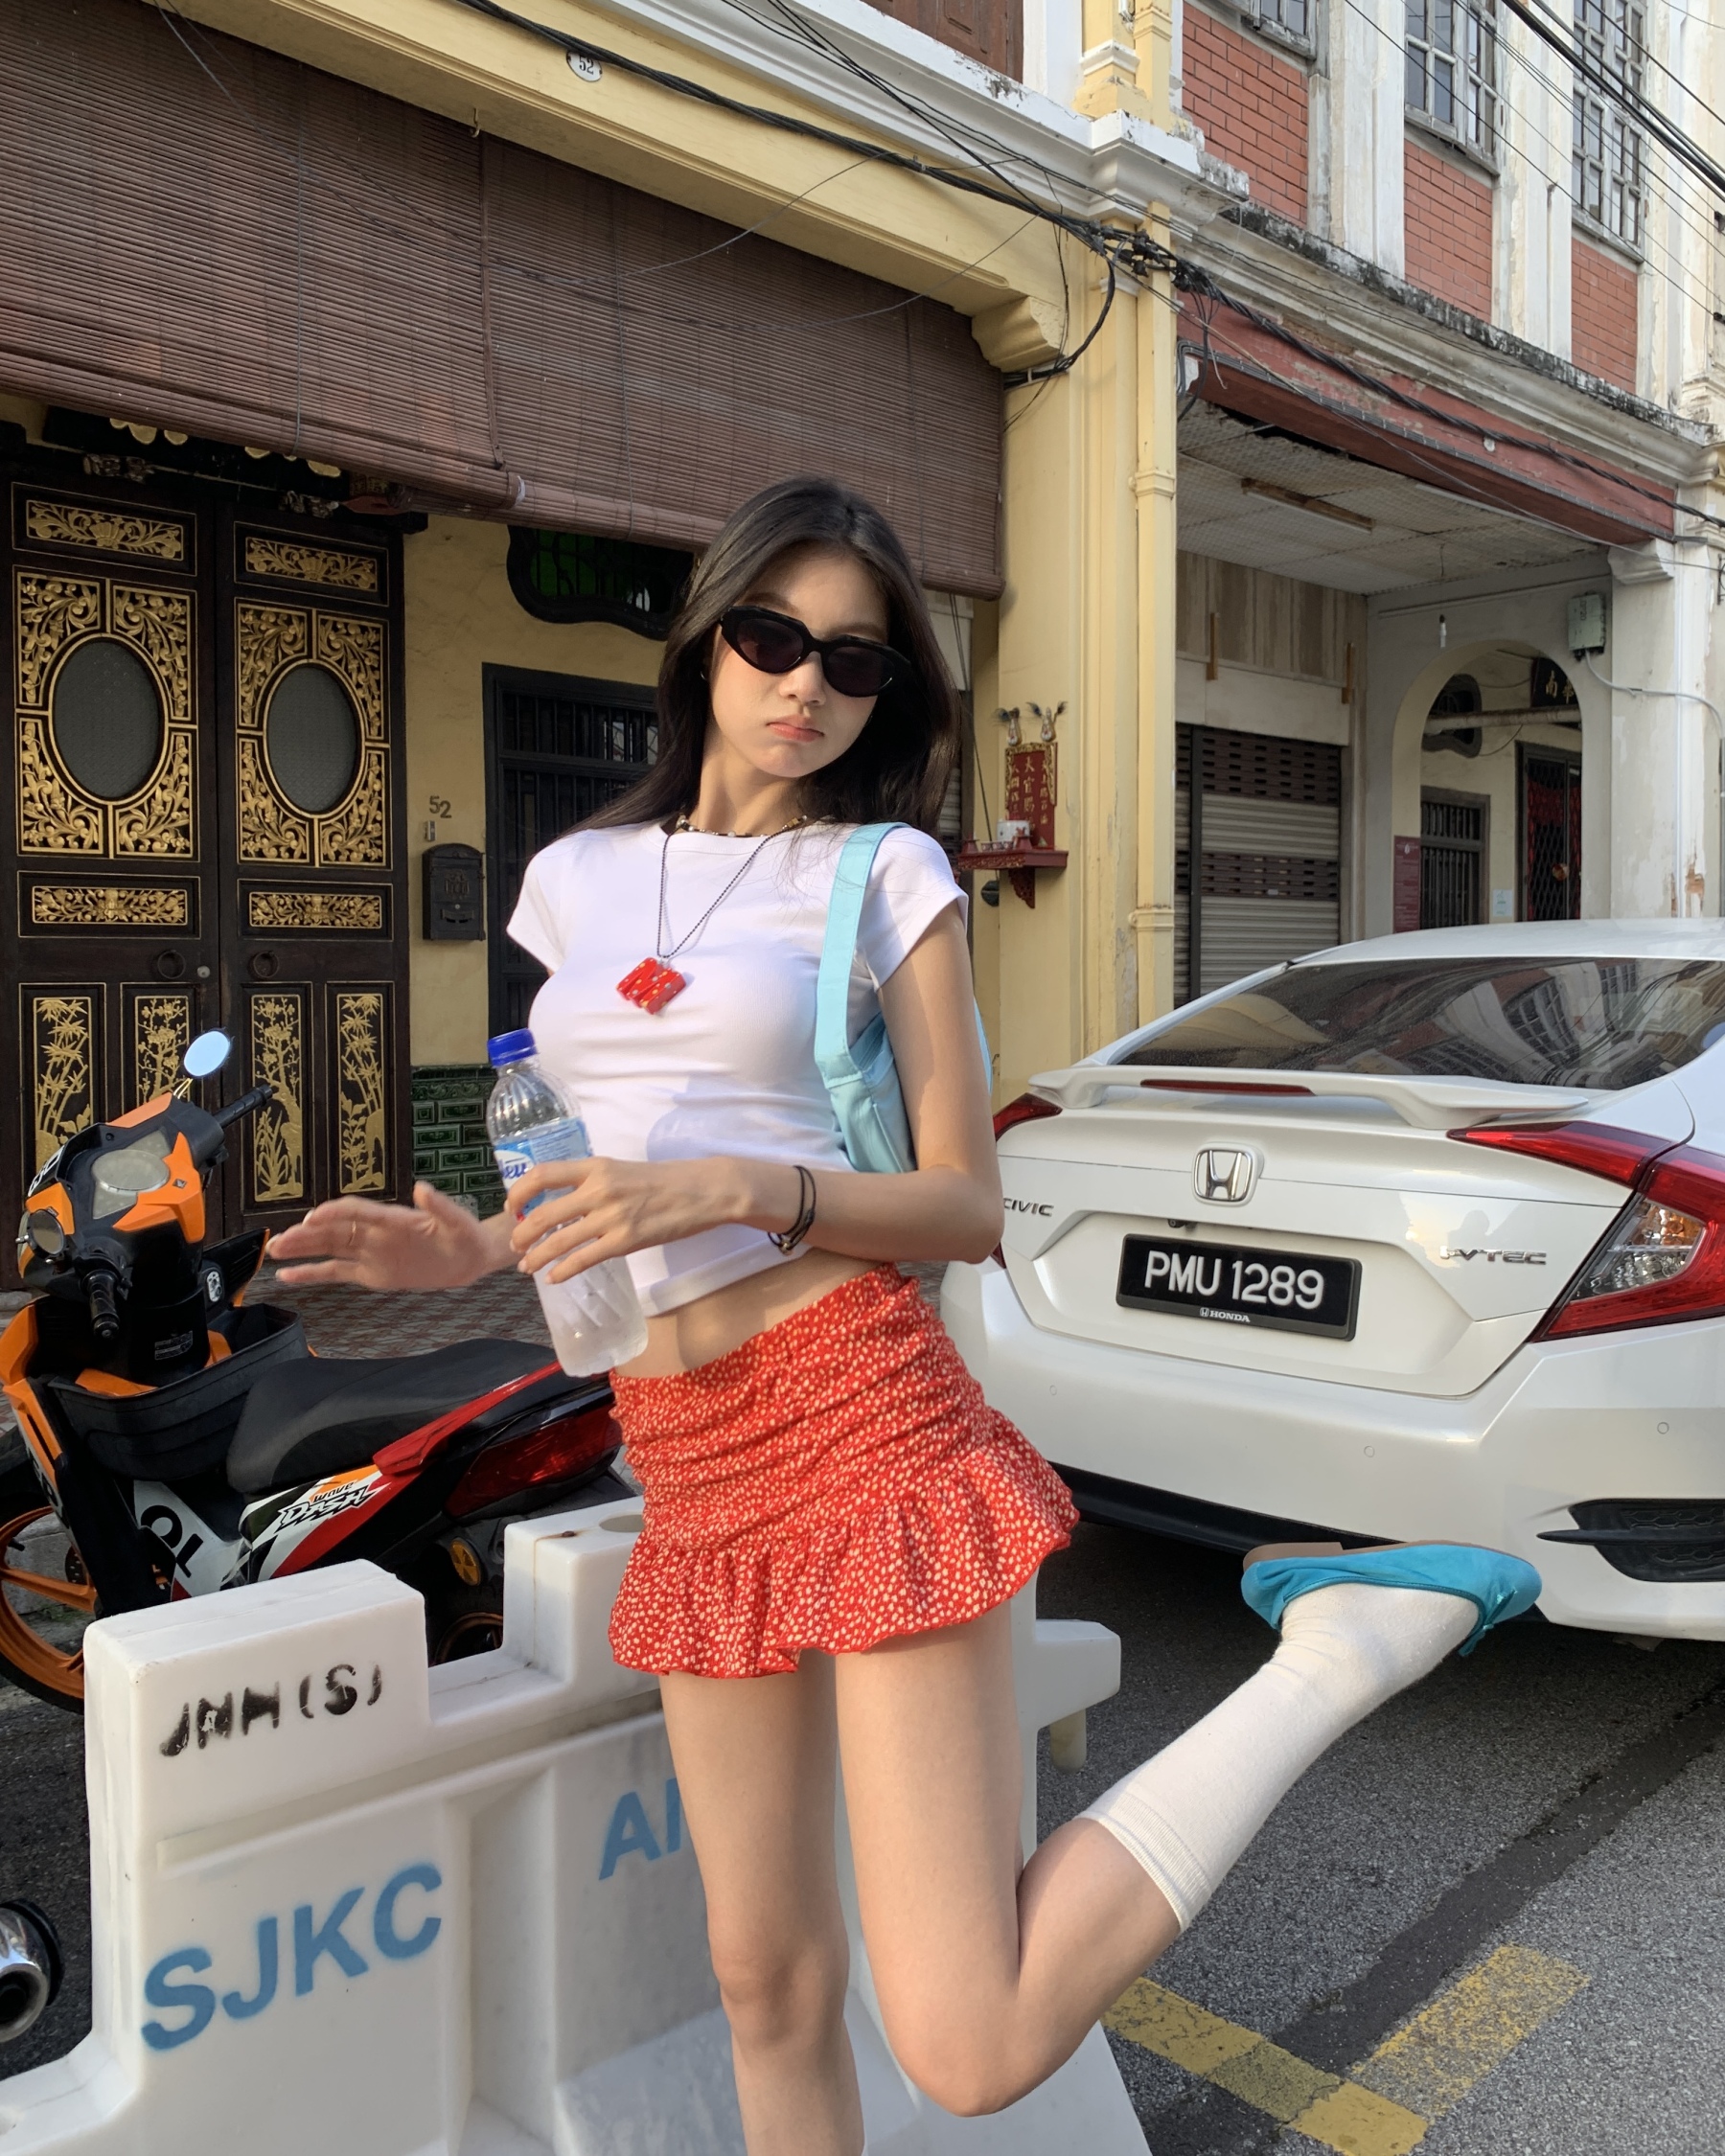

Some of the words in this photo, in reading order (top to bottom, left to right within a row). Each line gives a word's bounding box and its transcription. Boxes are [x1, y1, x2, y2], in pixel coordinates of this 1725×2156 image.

[579, 55, 594, 75] 52
[428, 795, 451, 818] 52
[1003, 1198, 1054, 1217] CIVIC
[1144, 1250, 1222, 1296] PMU
[1231, 1259, 1324, 1310] 1289
[1209, 1310, 1251, 1322] HONDA
[140, 1863, 444, 2052] SJKC
